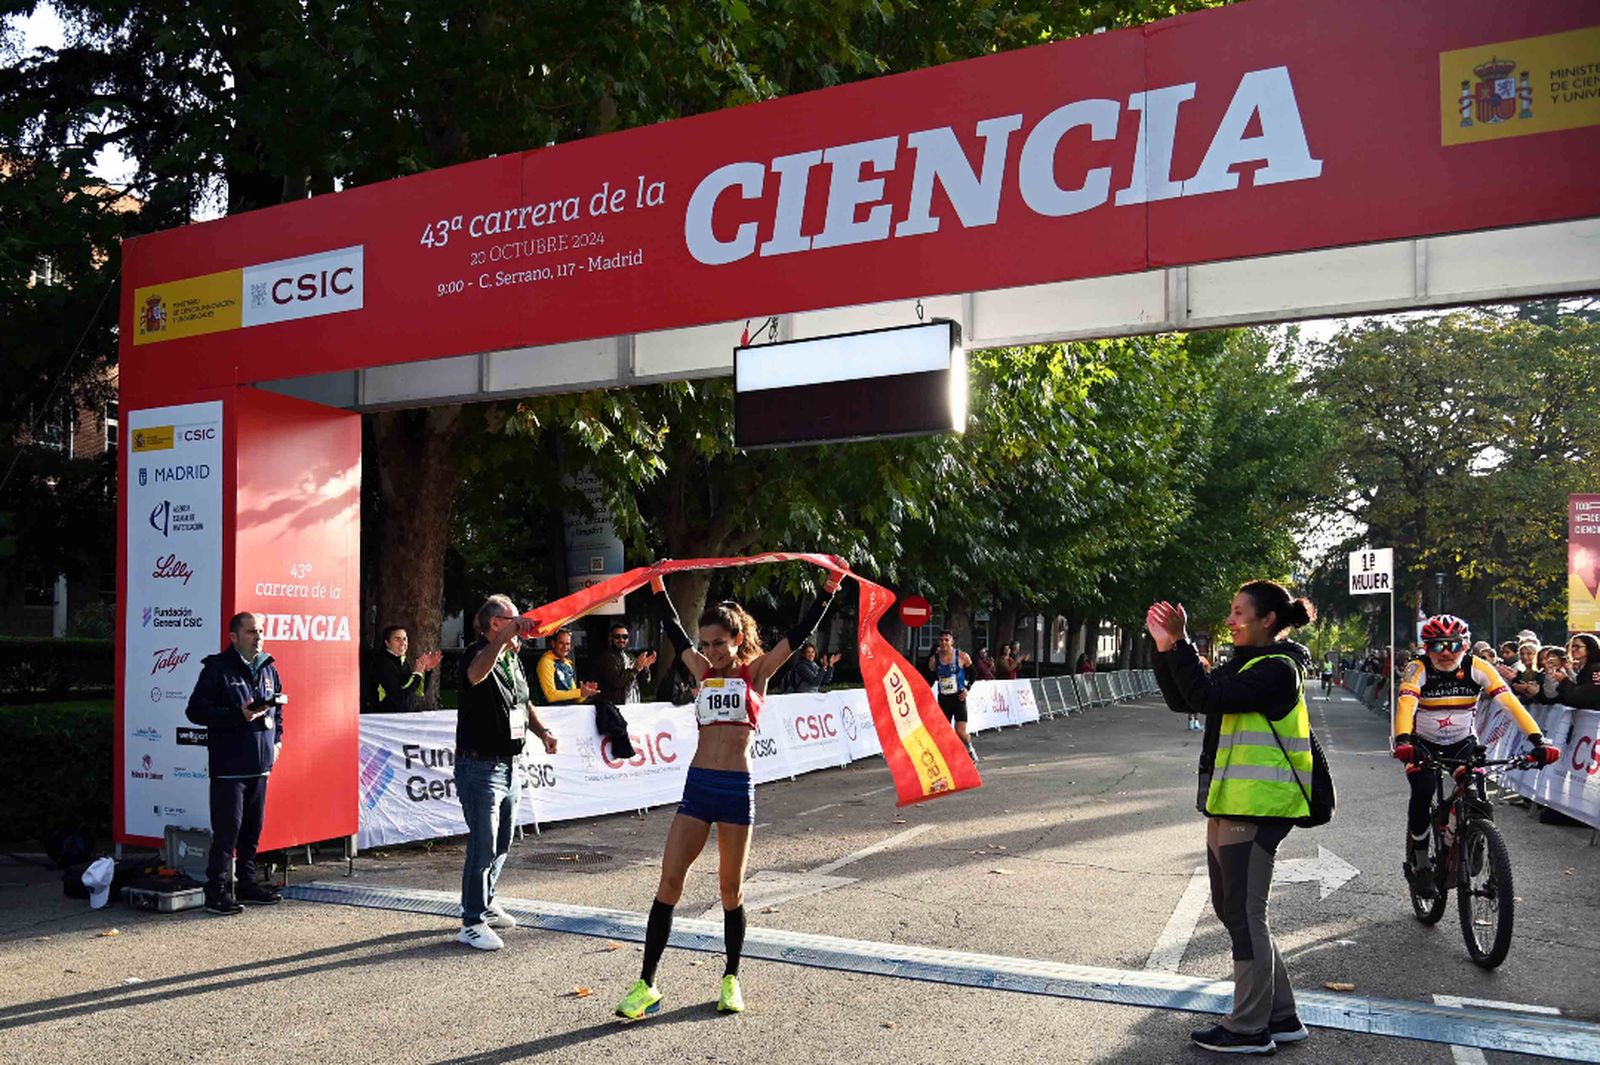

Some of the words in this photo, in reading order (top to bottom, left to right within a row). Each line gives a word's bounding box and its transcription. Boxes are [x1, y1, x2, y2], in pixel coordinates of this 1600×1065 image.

[1551, 80, 1568, 92] DE
[1551, 94, 1559, 104] Y
[1563, 88, 1600, 103] UNIV
[685, 65, 1323, 265] CIENCIA
[420, 214, 463, 249] 43ª
[468, 196, 581, 238] carrera
[589, 182, 626, 217] de
[636, 176, 666, 208] la
[470, 251, 487, 266] 20
[489, 234, 569, 262] OCTUBRE
[572, 231, 605, 249] 2024
[437, 279, 465, 297] 9:00
[479, 273, 493, 288] C.
[495, 267, 554, 287] Serrano,
[556, 263, 575, 278] 117
[588, 249, 643, 271] Madrid
[272, 266, 354, 305] CSIC
[184, 428, 216, 441] CSIC
[155, 464, 210, 482] MADRID
[152, 554, 193, 585] Lilly
[1352, 572, 1389, 590] MUJER
[256, 583, 309, 598] carrera
[312, 580, 327, 598] de
[330, 581, 342, 599] la
[154, 606, 192, 617] Fundación
[154, 618, 181, 627] General
[183, 617, 203, 627] CSIC
[151, 648, 191, 675] Talgo
[706, 693, 740, 710] 1840
[890, 672, 911, 718] CSIC
[795, 713, 837, 741] CSIC
